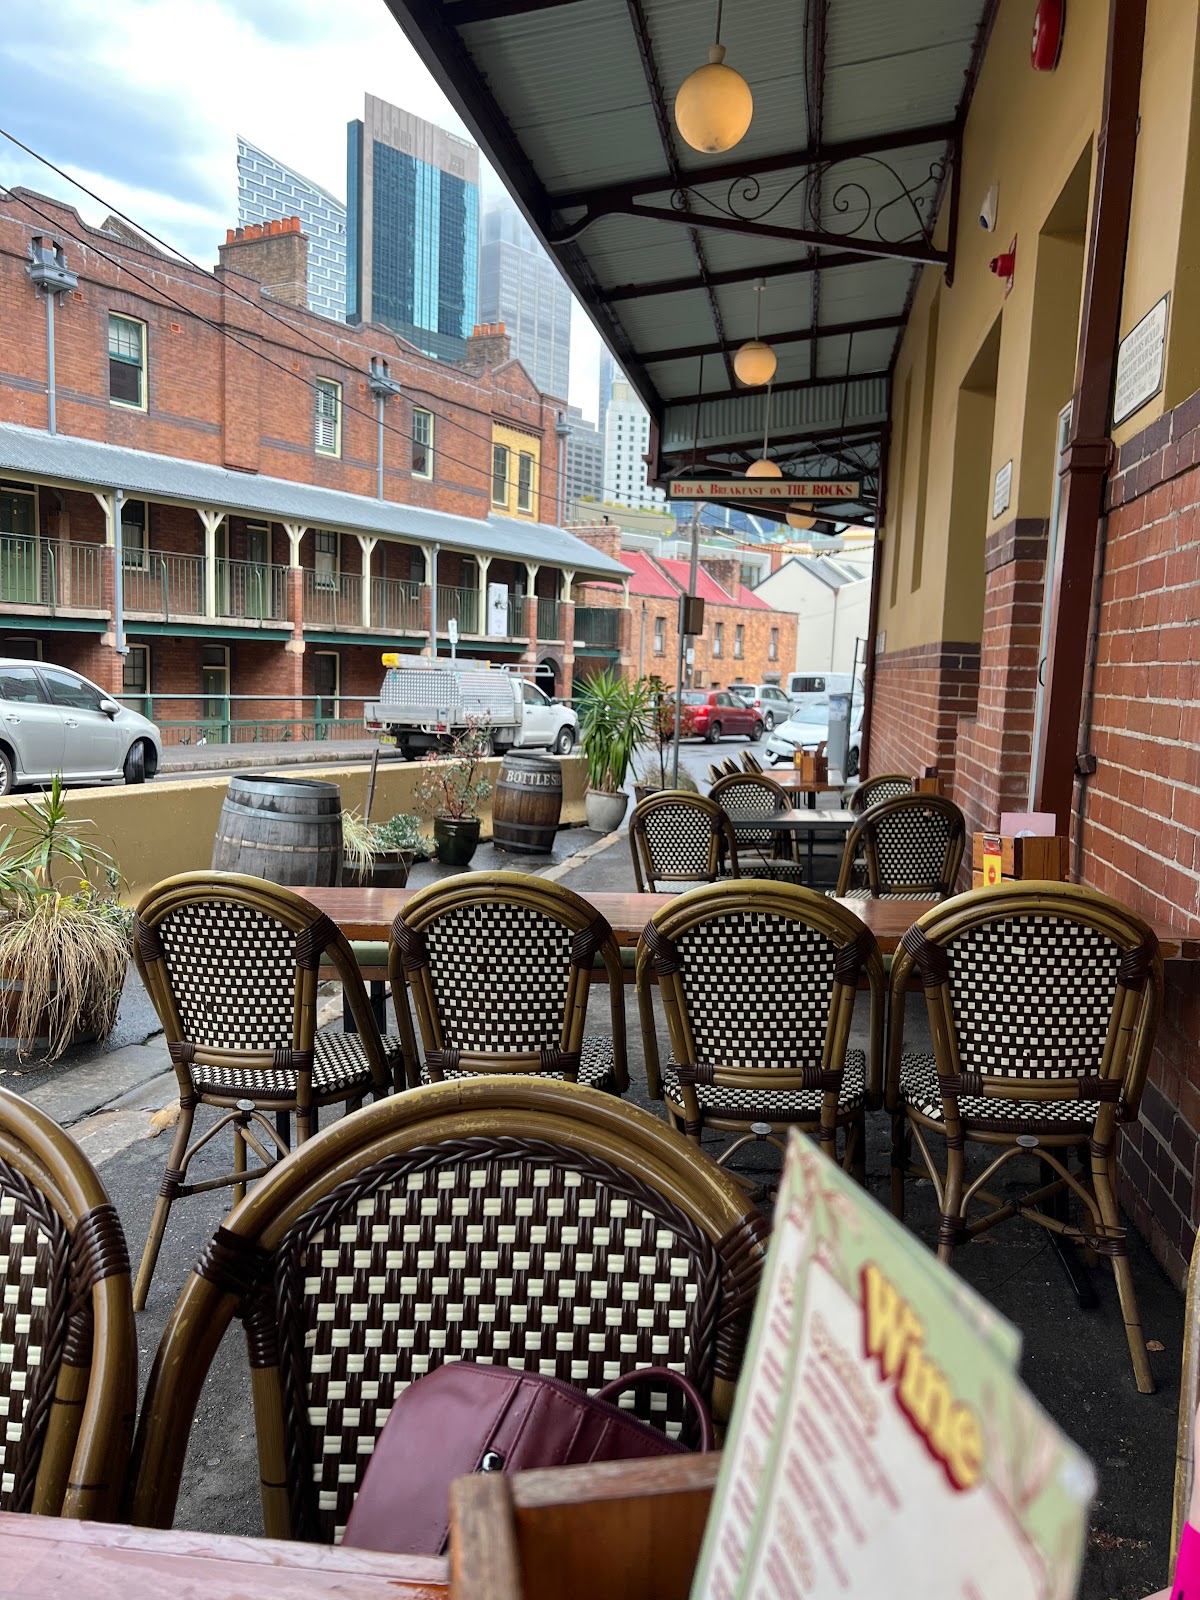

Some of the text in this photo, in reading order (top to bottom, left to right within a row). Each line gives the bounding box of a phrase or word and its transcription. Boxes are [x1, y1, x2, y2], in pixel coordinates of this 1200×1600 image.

[696, 483, 705, 495] &
[786, 484, 808, 496] THE
[812, 484, 853, 496] ROCKS
[859, 1260, 985, 1492] Wine
